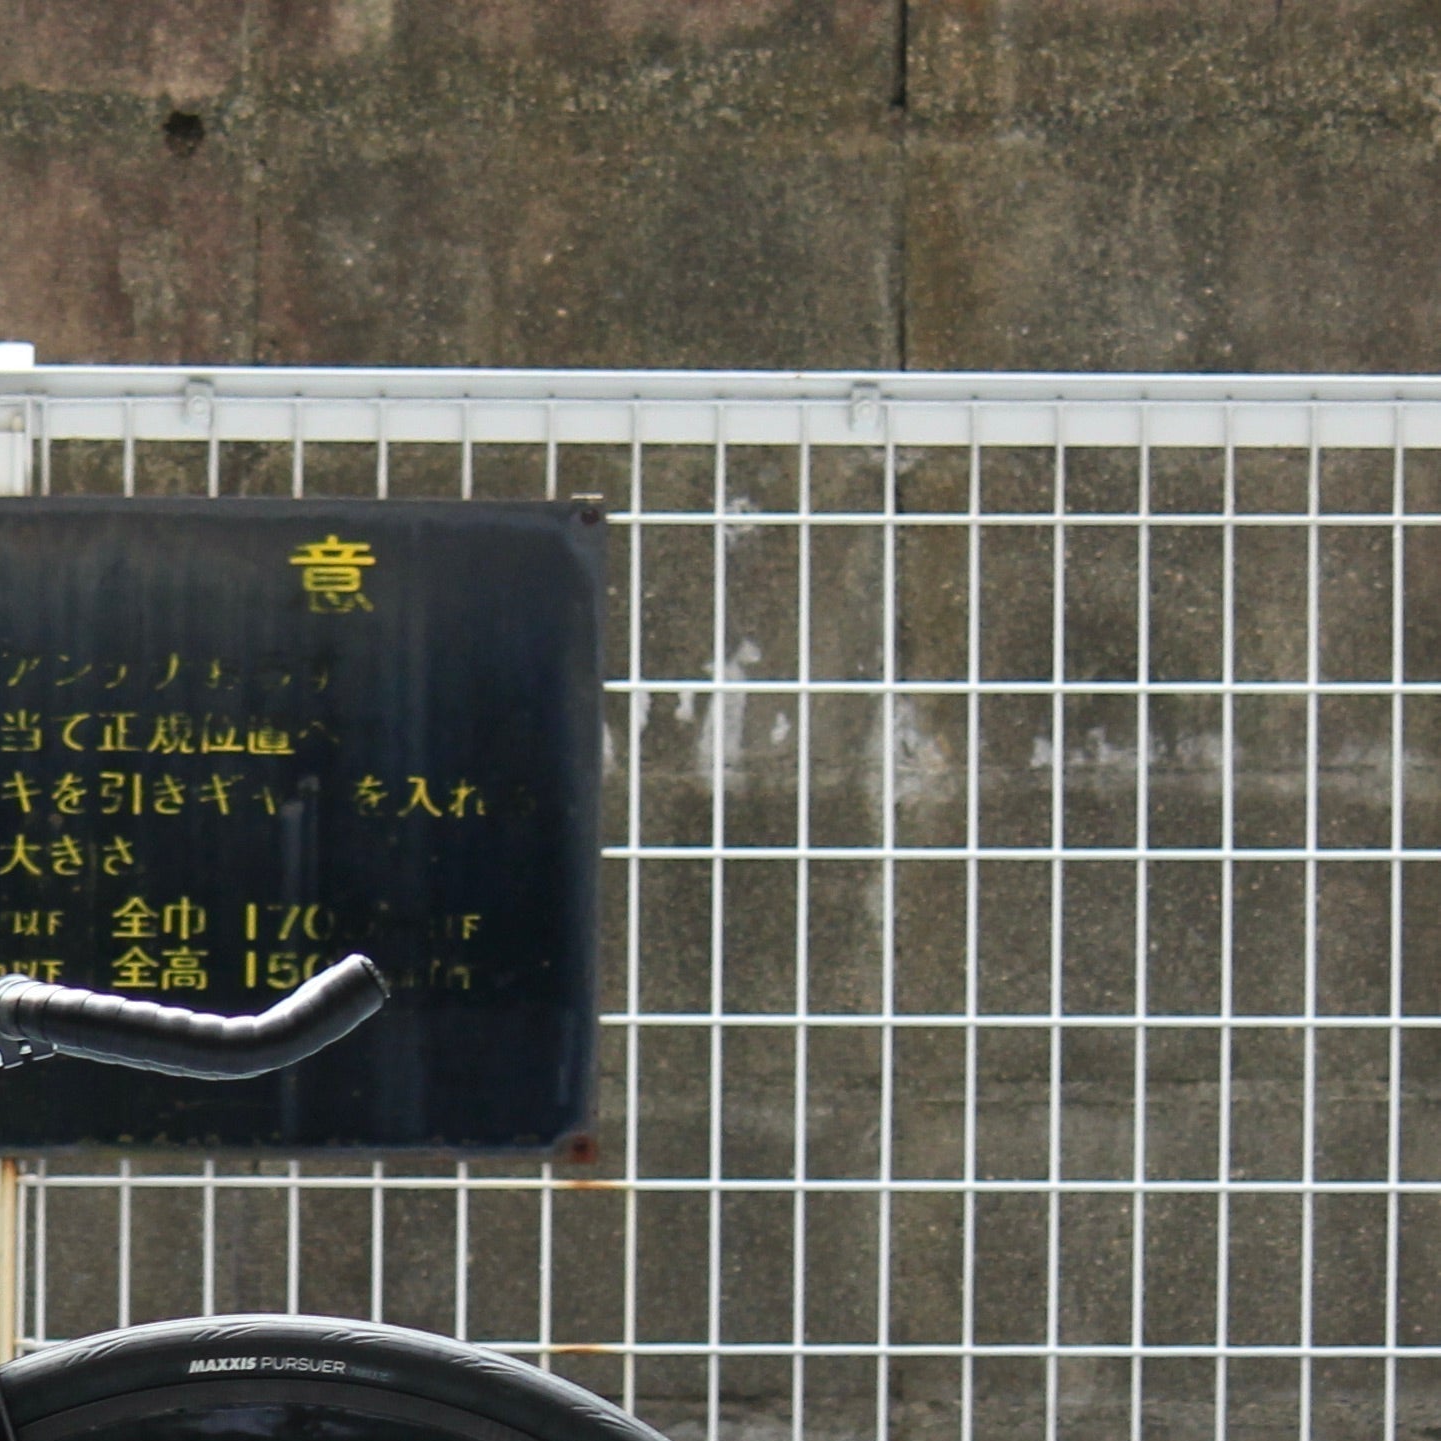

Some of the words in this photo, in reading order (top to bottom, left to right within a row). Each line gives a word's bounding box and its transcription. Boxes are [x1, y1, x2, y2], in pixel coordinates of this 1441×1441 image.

[289, 534, 376, 613] 意
[111, 945, 209, 992] 全高
[188, 1356, 258, 1374] MAXXIS
[260, 1356, 347, 1375] PURSUER
